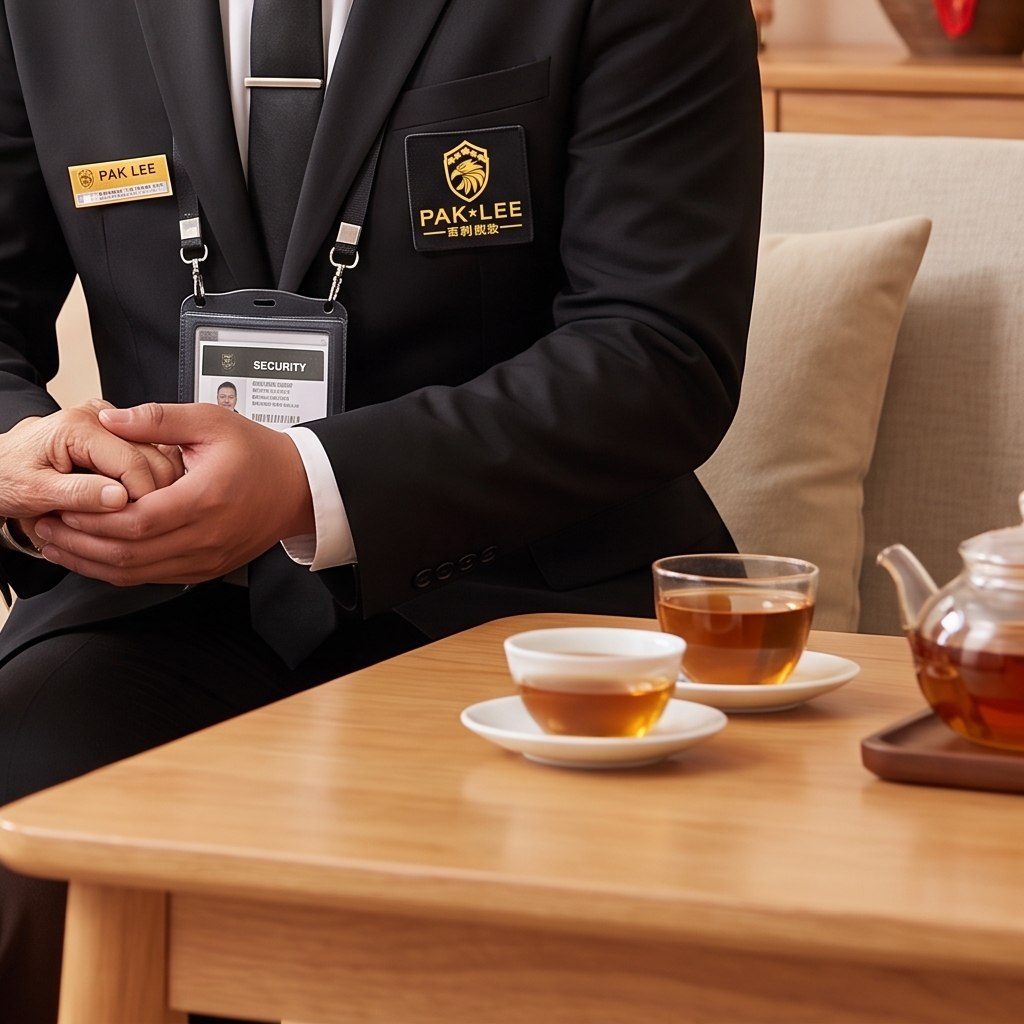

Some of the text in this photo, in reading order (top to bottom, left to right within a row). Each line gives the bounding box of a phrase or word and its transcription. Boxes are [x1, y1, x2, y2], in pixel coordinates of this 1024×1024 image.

[99, 163, 156, 181] PAK LEE
[419, 200, 523, 227] PAK LEE
[253, 360, 306, 372] SECURITY
